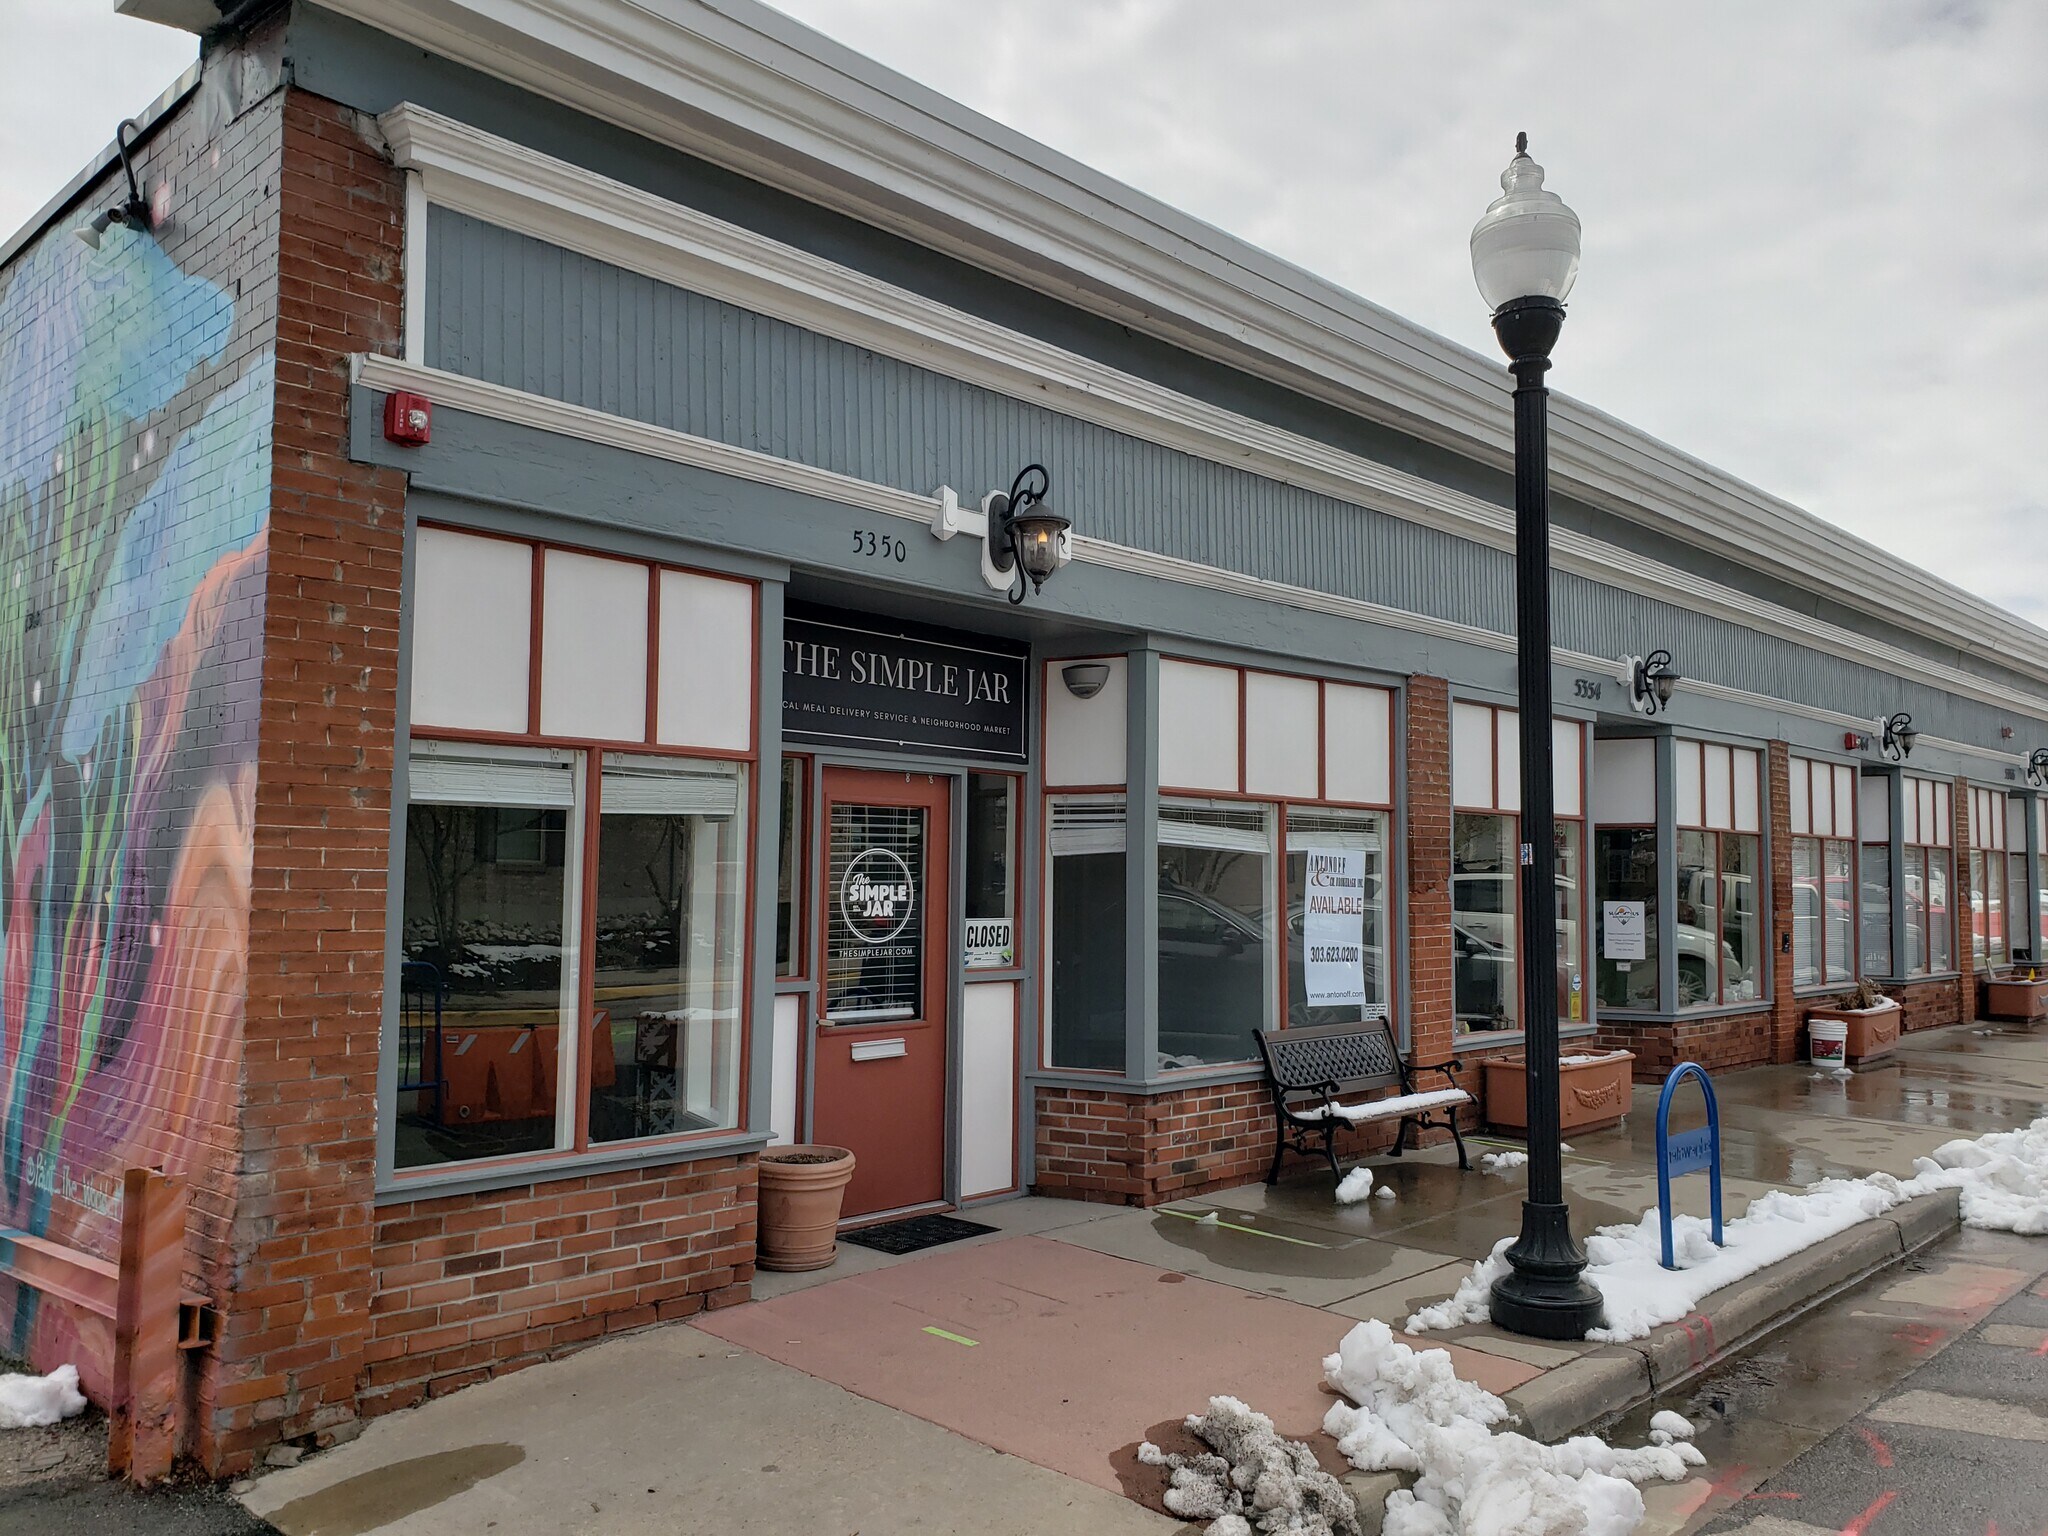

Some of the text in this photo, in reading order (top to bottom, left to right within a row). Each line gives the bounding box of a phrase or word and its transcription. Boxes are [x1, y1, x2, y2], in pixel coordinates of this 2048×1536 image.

[852, 529, 906, 563] 5350
[782, 639, 1011, 706] THE SIMPLE JAR
[1573, 679, 1602, 701] 5354
[802, 702, 827, 714] MEAL
[829, 705, 871, 719] DELIVERY
[873, 710, 909, 724] SERVICE
[911, 715, 917, 724] &
[920, 717, 982, 732] NEIGHBORHOOD
[983, 724, 1011, 736] MARKET
[1308, 854, 1347, 874] ANTONOFF
[852, 873, 871, 886] The
[849, 884, 907, 902] SIMPLE
[863, 900, 894, 917] JAR
[1309, 895, 1362, 915] AVAILABLE
[966, 925, 1010, 949] CLOSED
[839, 948, 913, 958] THESIMPLEJAR.COM
[1310, 946, 1359, 963] 303.623.0200
[1309, 990, 1364, 1000] www.antonoff.com
